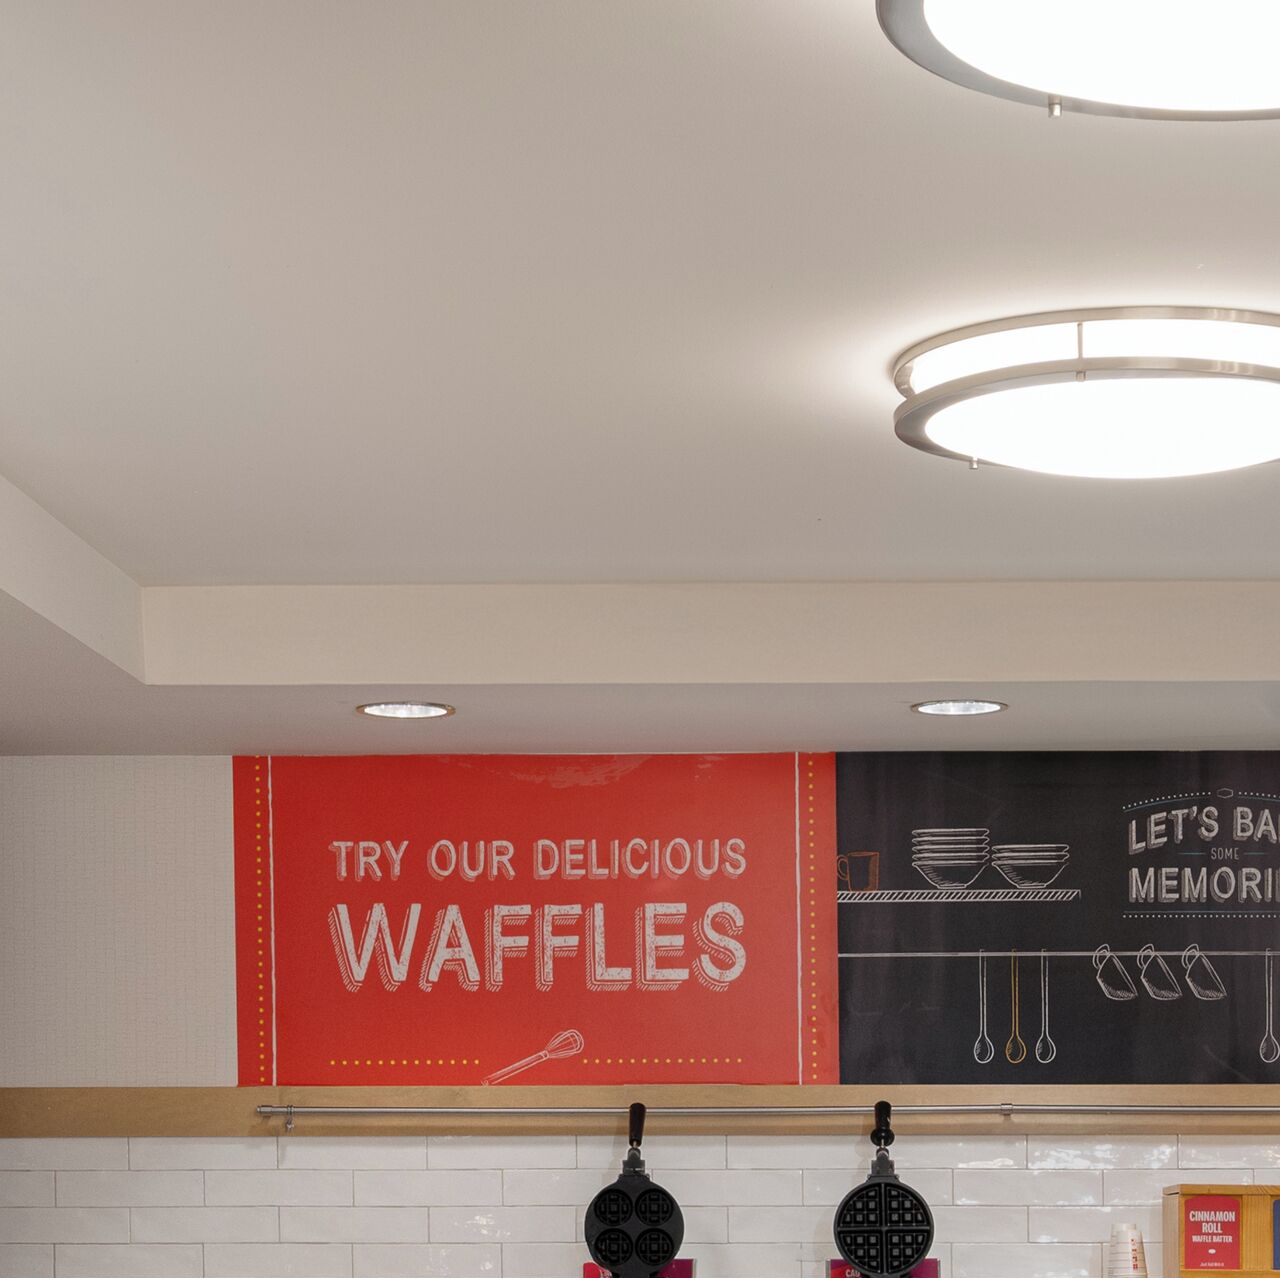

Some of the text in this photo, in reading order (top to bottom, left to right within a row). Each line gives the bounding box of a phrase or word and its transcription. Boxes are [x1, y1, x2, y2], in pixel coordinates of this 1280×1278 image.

[1128, 805, 1220, 855] LET'S
[329, 838, 747, 882] TRY OUR DELICIOUS
[1210, 847, 1240, 861] SOME
[328, 901, 747, 993] WAFFLES
[1189, 1210, 1236, 1222] CINNAMON
[1202, 1222, 1223, 1234] ROLL
[1192, 1235, 1233, 1243] WAFFLE BATTER
